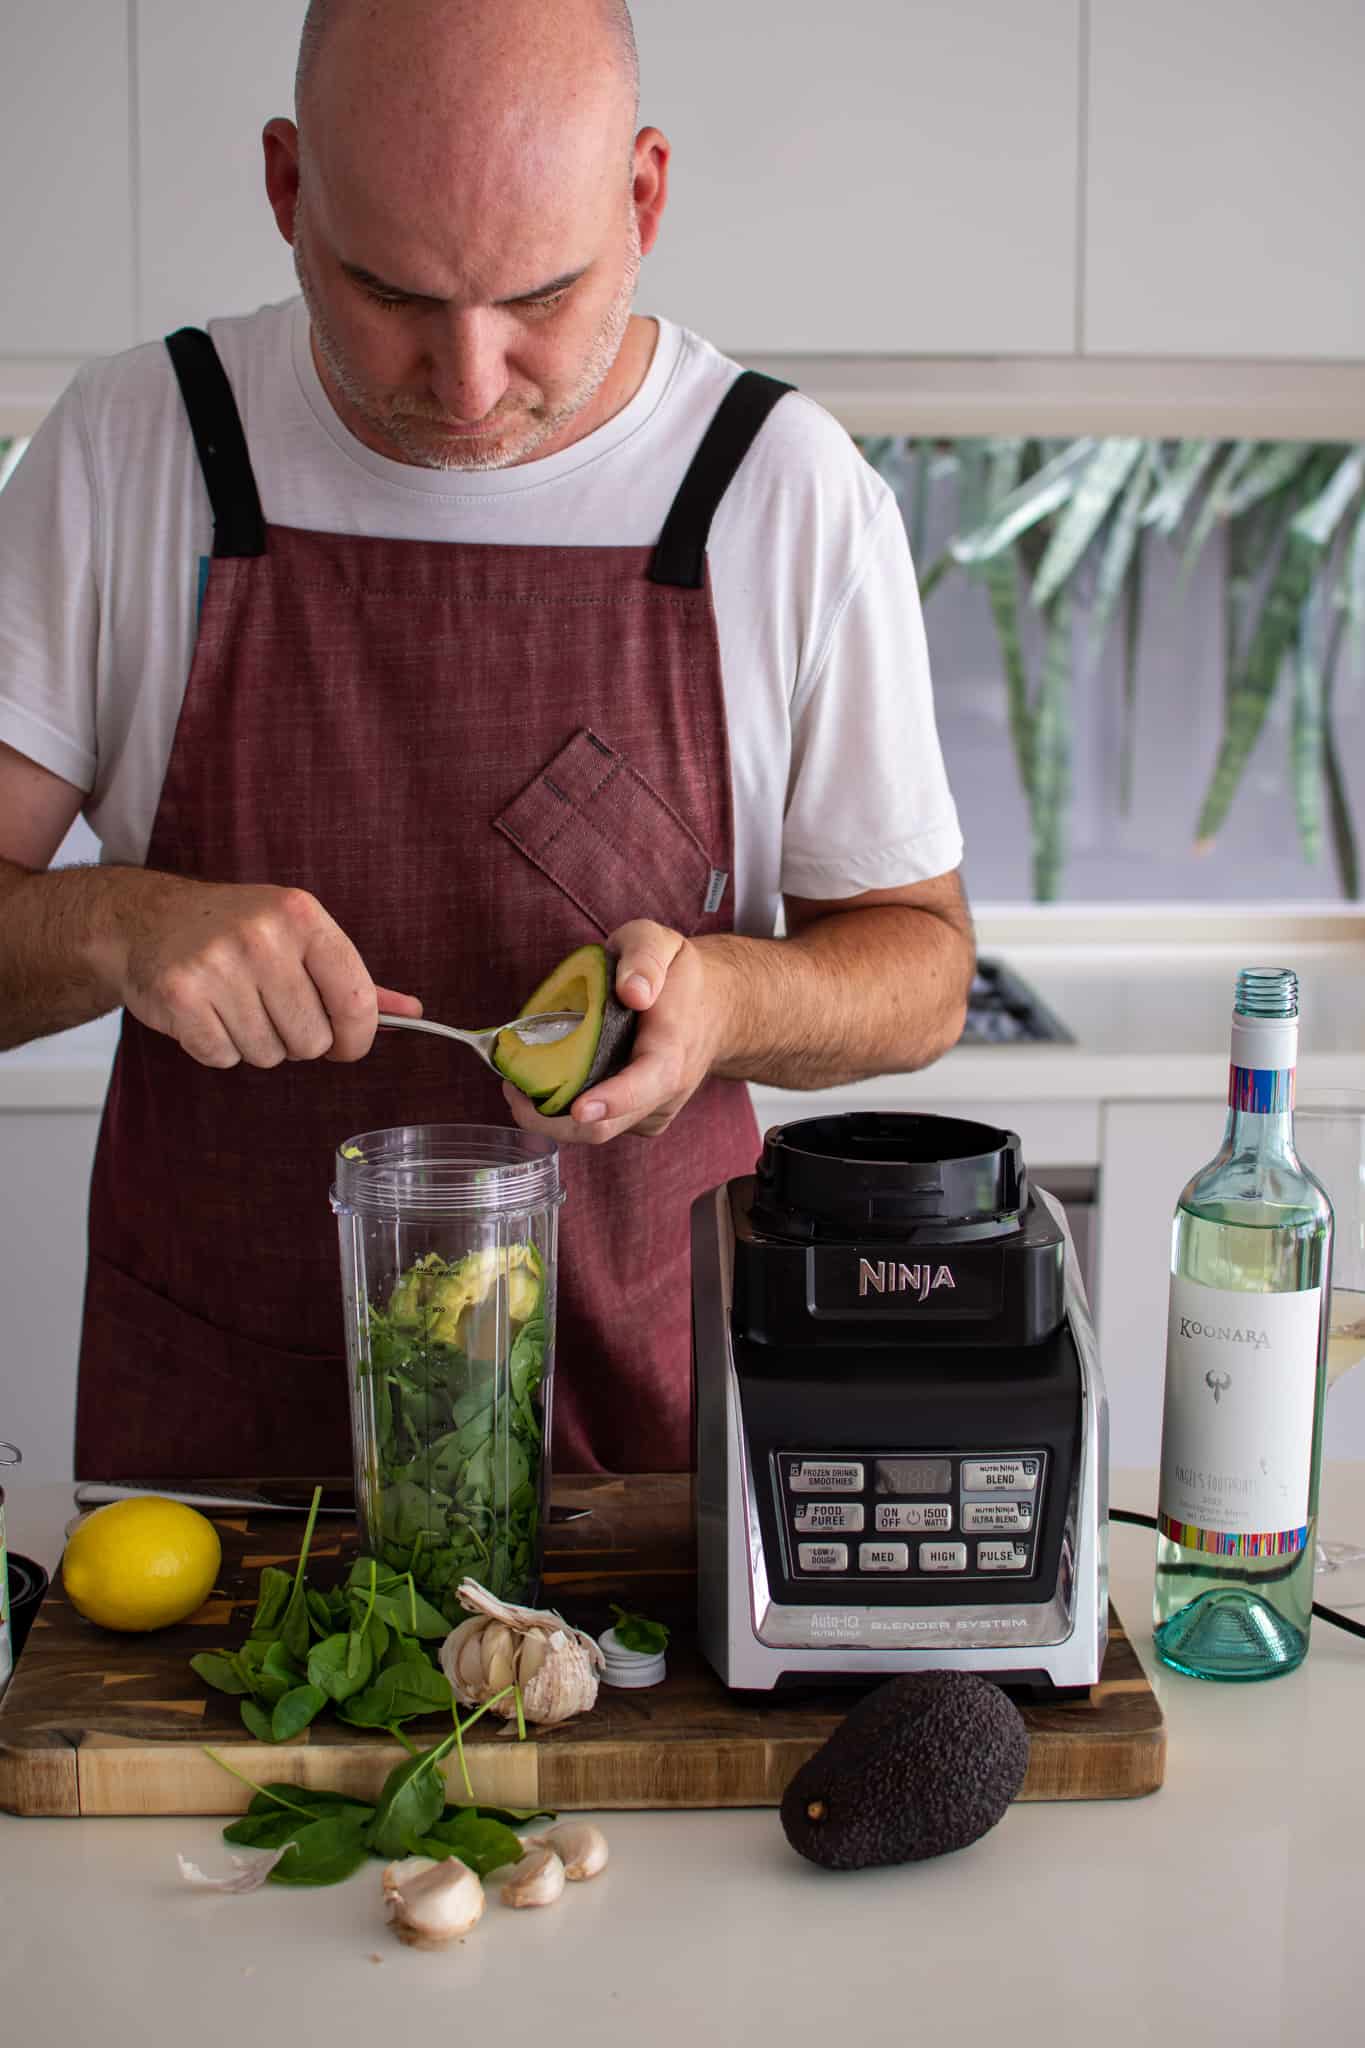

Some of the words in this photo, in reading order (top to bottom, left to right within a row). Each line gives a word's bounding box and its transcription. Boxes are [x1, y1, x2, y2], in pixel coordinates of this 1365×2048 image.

[859, 1258, 956, 1302] NINJA
[1179, 1317, 1272, 1350] KOONARA
[802, 1468, 831, 1477] FROZEN
[831, 1468, 859, 1477] DRINKS
[808, 1477, 854, 1486] SMOOTHIES
[986, 1474, 1015, 1485] BLEND
[814, 1505, 842, 1516] FOOD
[883, 1507, 899, 1517] ON
[923, 1508, 948, 1518] 1500
[811, 1516, 845, 1526] PUREE
[881, 1518, 901, 1528] OFF
[924, 1518, 948, 1527] WATTS
[972, 1515, 994, 1524] ULTRA
[995, 1515, 1018, 1524] BLEND
[871, 1552, 894, 1562] MED
[930, 1551, 956, 1561] HIGH
[980, 1551, 1014, 1561] PULSE
[871, 1621, 949, 1631] BLENDER
[955, 1616, 1029, 1630] SYSTEM
